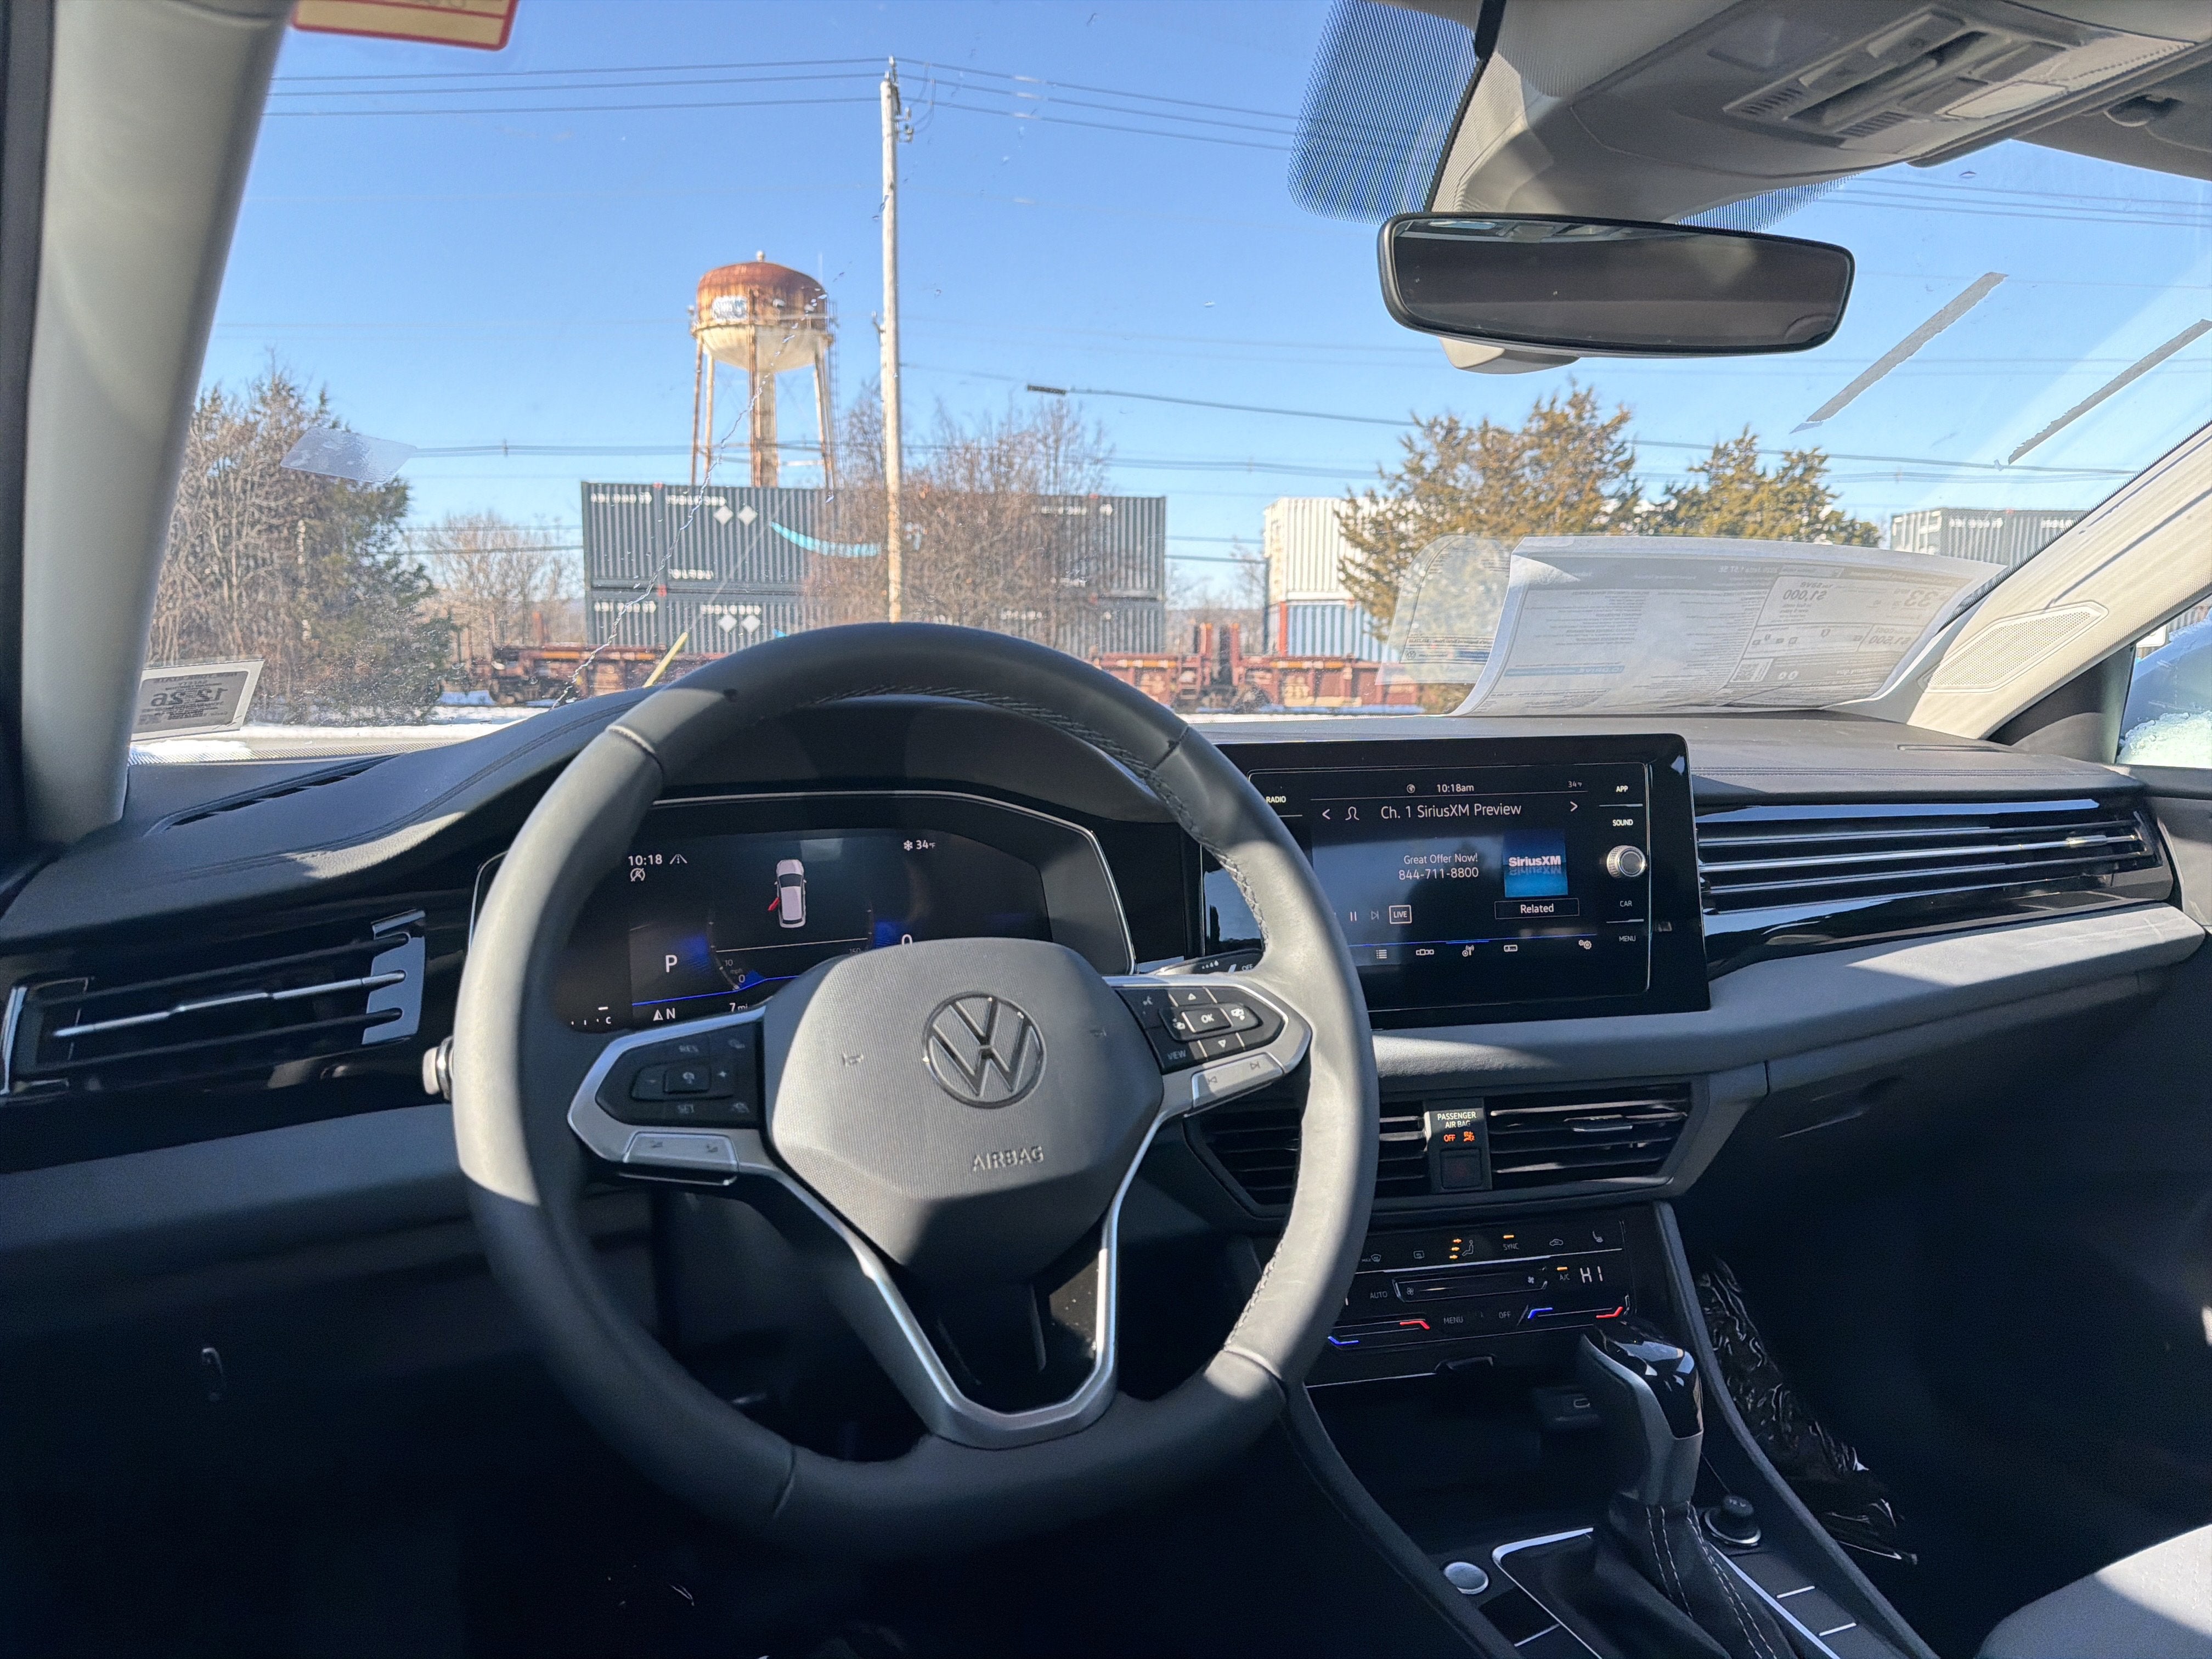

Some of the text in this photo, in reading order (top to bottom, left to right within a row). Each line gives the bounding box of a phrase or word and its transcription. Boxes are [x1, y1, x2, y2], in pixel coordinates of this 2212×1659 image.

[1436, 783, 1474, 793] 10:18am
[1266, 795, 1286, 804] RADIO
[1380, 803, 1522, 819] Ch. 1 SiriusXM Preview
[1612, 819, 1634, 827] SOUND
[628, 854, 663, 866] 10:18
[1403, 853, 1478, 865] Great Offer Now!
[1509, 855, 1561, 867] SiriusXM
[1398, 867, 1479, 881] 844-711-8800
[1520, 903, 1554, 914] Related
[665, 954, 678, 973] P
[1241, 963, 1254, 972] OFF
[738, 974, 746, 983] 0
[729, 1002, 736, 1013] 7
[665, 1007, 676, 1020] N
[605, 1017, 612, 1025] C
[1200, 1014, 1215, 1024] OK
[1167, 1049, 1187, 1061] VIEW
[1437, 1111, 1477, 1121] PASSENGER
[1457, 1120, 1471, 1128] BAG
[1443, 1134, 1456, 1142] OFF
[972, 1146, 1045, 1172] AIRBAG
[1503, 1243, 1520, 1251] SYNC
[1579, 1266, 1604, 1284] HI
[1370, 1291, 1388, 1299] AUTO
[1498, 1311, 1511, 1319] OFF
